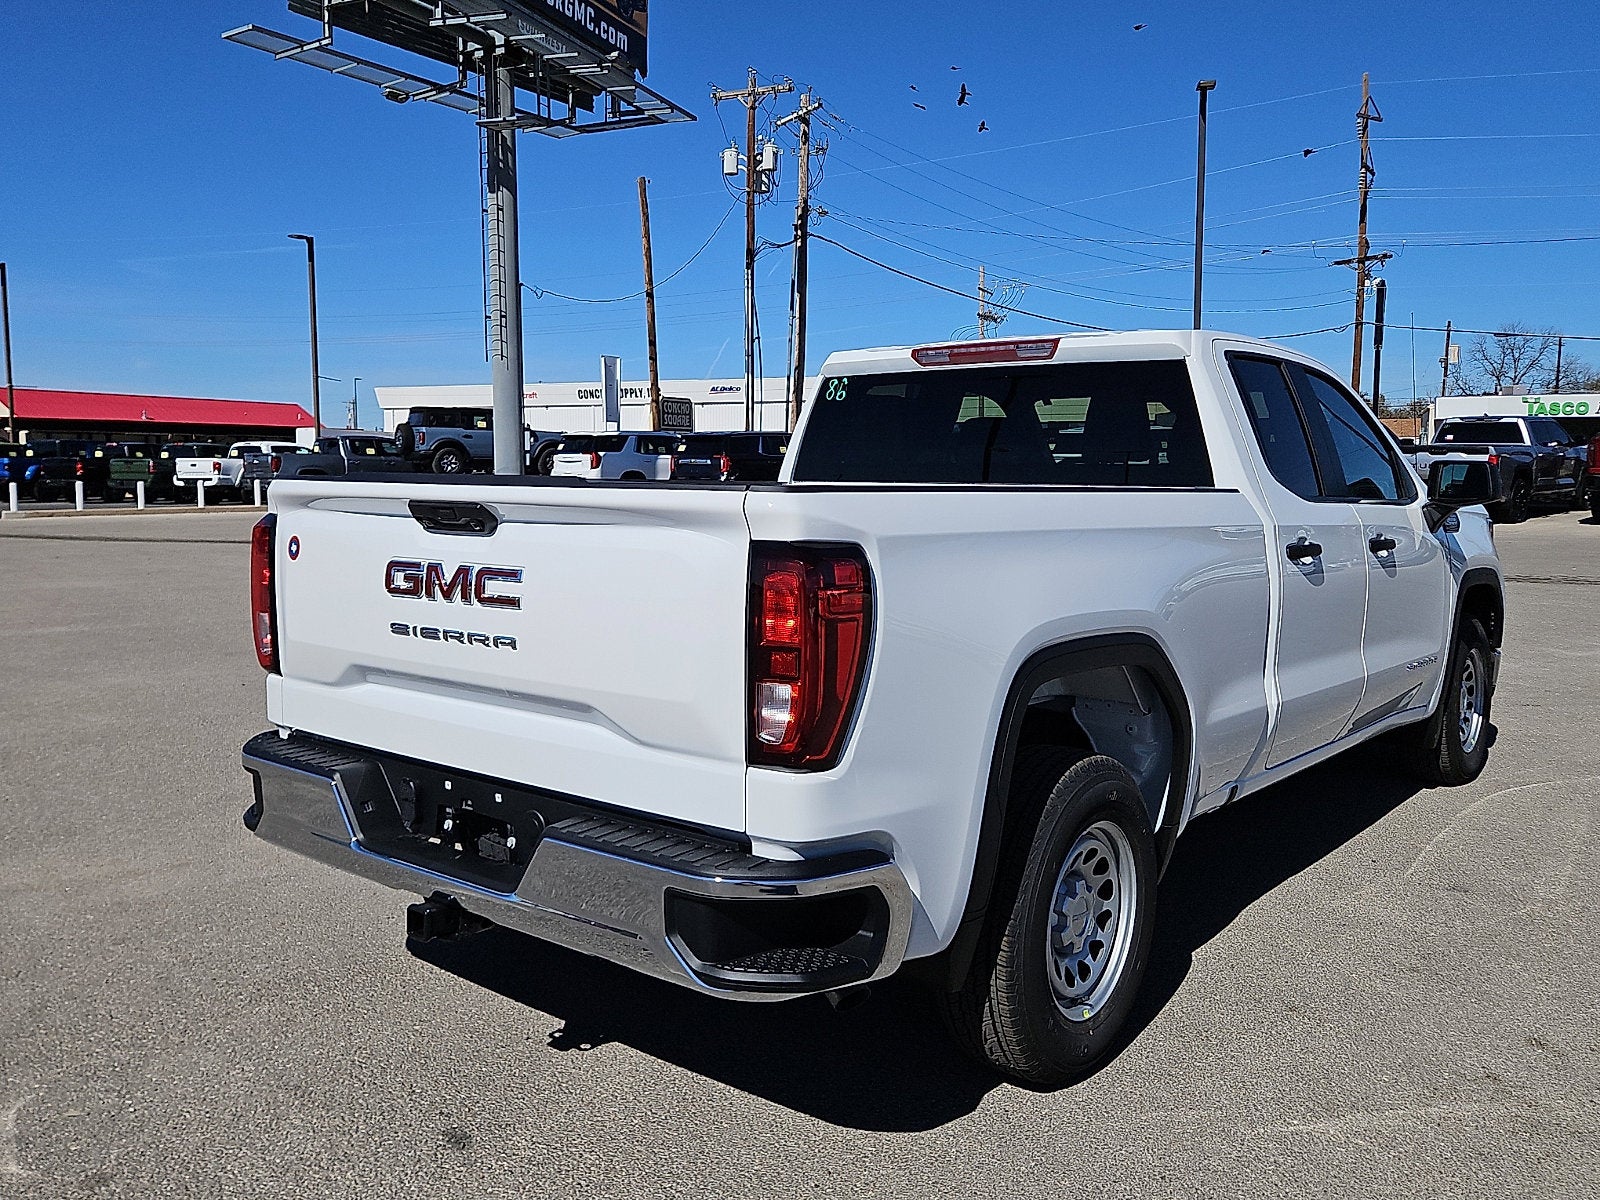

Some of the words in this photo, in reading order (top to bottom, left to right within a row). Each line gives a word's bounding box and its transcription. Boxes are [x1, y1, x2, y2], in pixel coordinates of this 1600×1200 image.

[577, 388, 603, 400] CONC
[663, 401, 690, 414] CONCHO
[1521, 396, 1590, 416] TASCO
[663, 414, 690, 426] SQUARE
[384, 557, 525, 610] GMC
[389, 621, 519, 651] SIERRA
